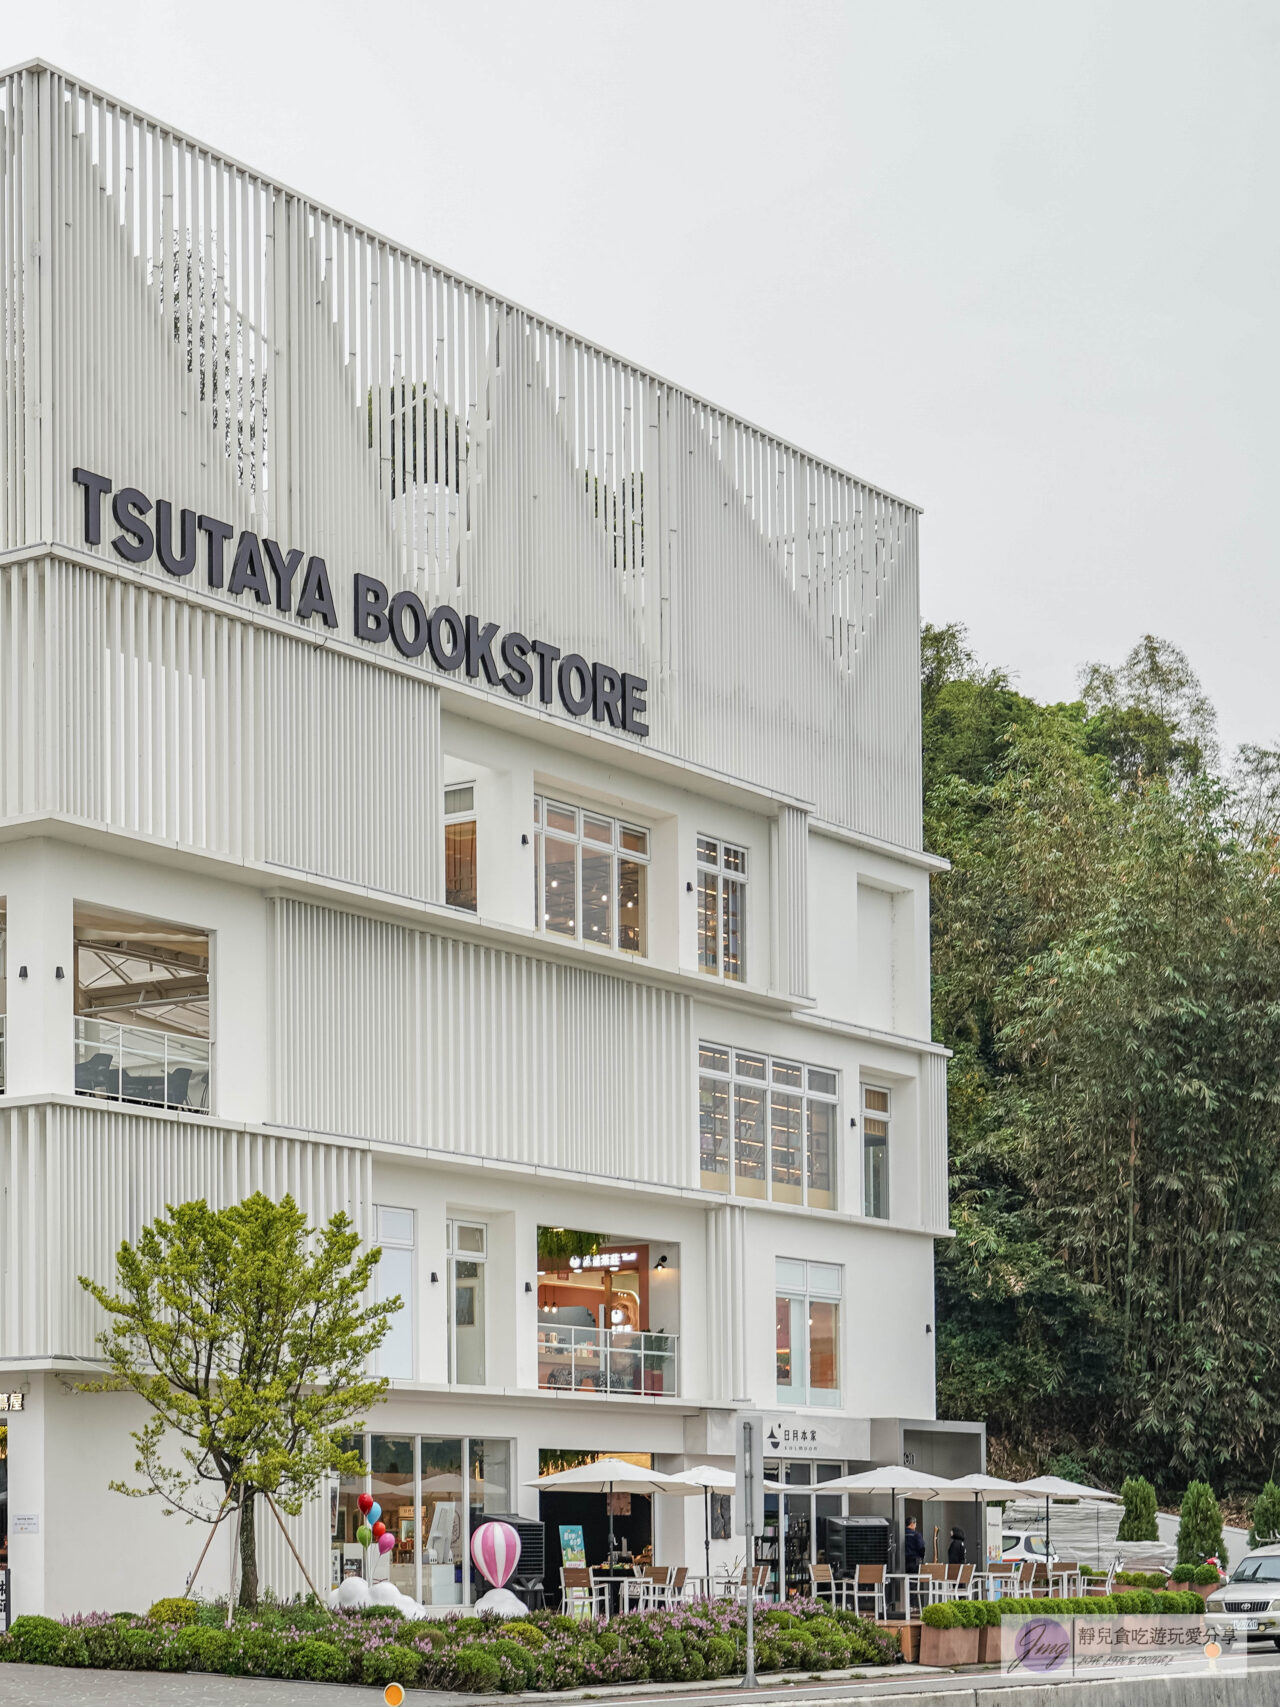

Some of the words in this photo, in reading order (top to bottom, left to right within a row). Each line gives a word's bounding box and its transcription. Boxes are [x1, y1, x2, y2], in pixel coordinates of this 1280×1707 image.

[73, 467, 338, 629] TSUTAYA
[354, 572, 649, 737] BOOKSTORE
[784, 1429, 817, 1441] 日月本家
